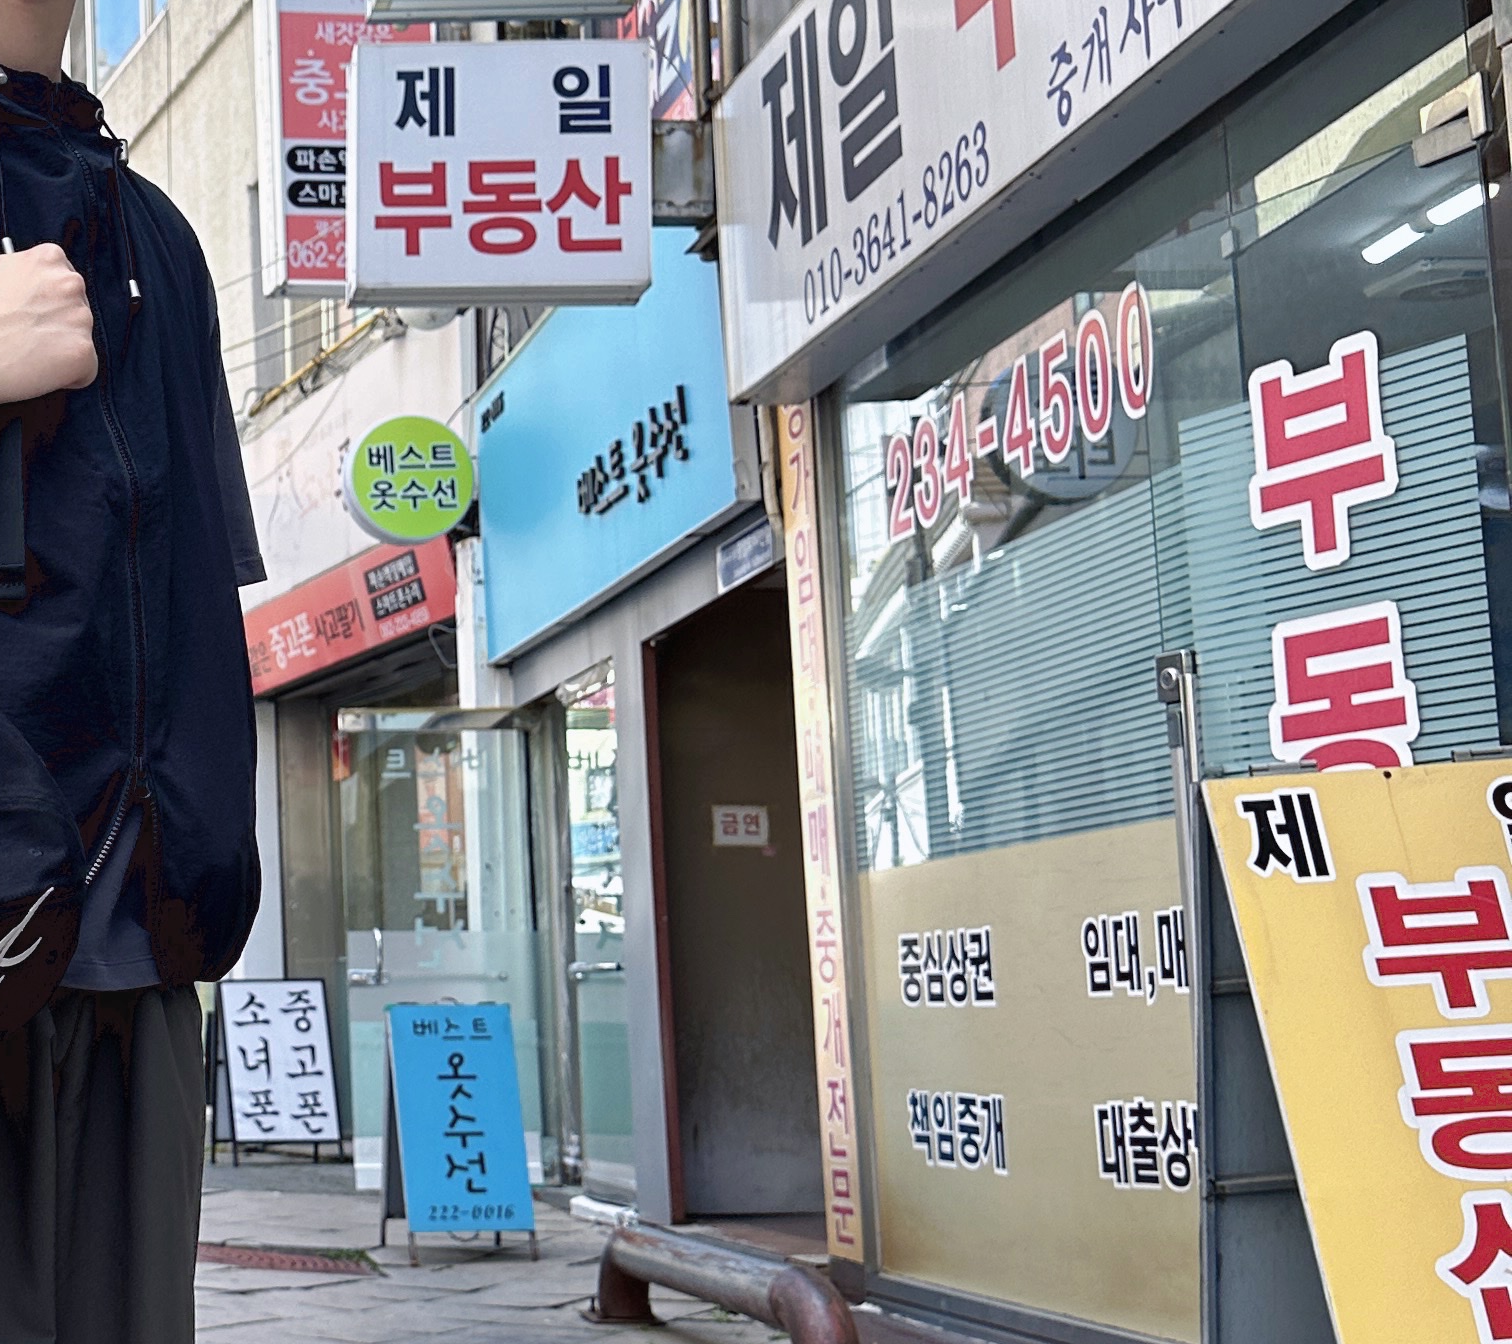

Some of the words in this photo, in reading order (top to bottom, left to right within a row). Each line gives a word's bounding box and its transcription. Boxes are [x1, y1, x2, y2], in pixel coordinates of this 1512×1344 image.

[396, 66, 456, 137] 제
[553, 65, 613, 135] 일
[297, 184, 346, 206] 스마
[374, 156, 632, 257] 부동산
[804, 120, 991, 325] 010-3641-8263
[886, 281, 1153, 543] 234-4500
[367, 443, 457, 474] 베스트
[369, 479, 459, 511] 옷수선
[268, 611, 317, 670] 중고폰
[720, 812, 761, 835] 금연
[1236, 787, 1335, 882] 제
[899, 927, 996, 1007] 중심상권
[232, 992, 282, 1137] 소녀폰
[278, 989, 330, 1136] 중고폰
[411, 1016, 494, 1042] 베스트
[436, 1052, 490, 1194] 옷수선
[908, 1089, 1008, 1175] 책임중개
[1094, 1099, 1198, 1189] 대출상
[427, 1203, 516, 1223] 222-0016
